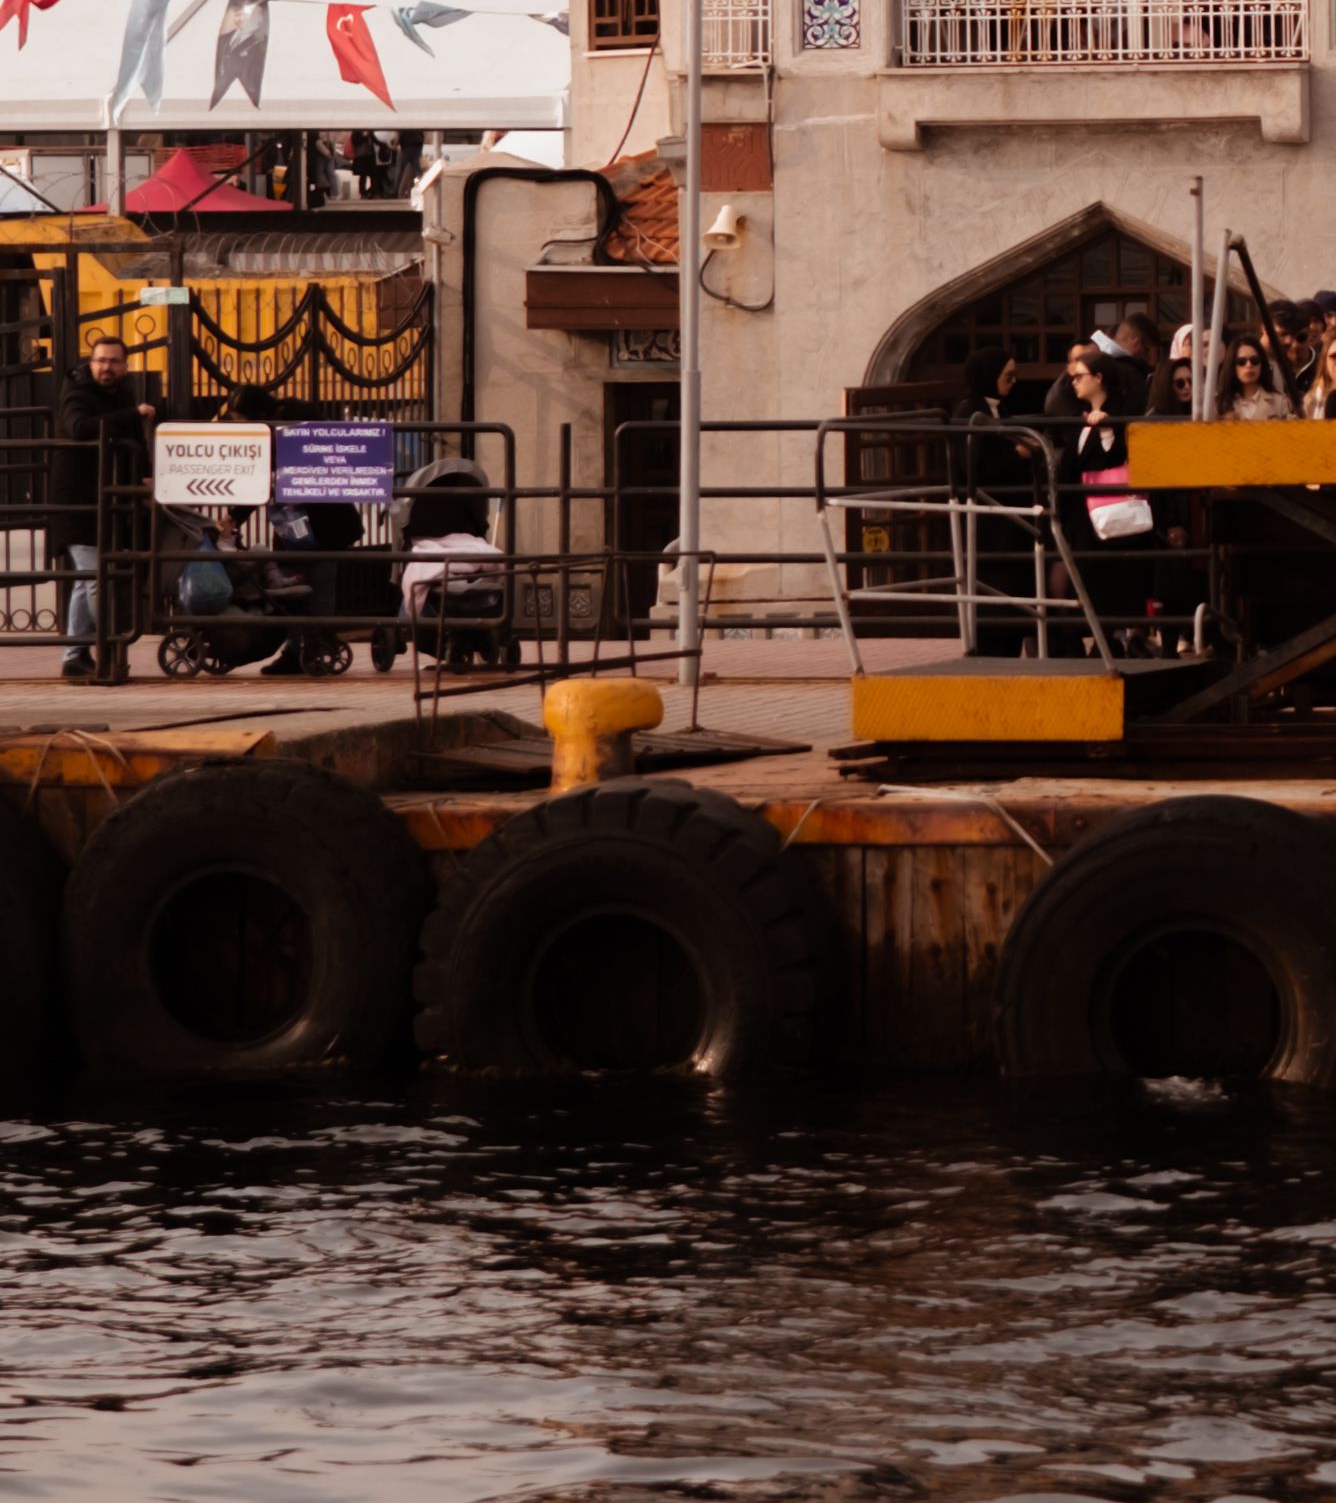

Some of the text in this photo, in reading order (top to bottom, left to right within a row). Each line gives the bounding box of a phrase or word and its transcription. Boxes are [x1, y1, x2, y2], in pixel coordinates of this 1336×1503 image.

[165, 444, 262, 461] YOLCU ÇIKIŞI
[169, 463, 256, 475] PASSENGER EXIT
